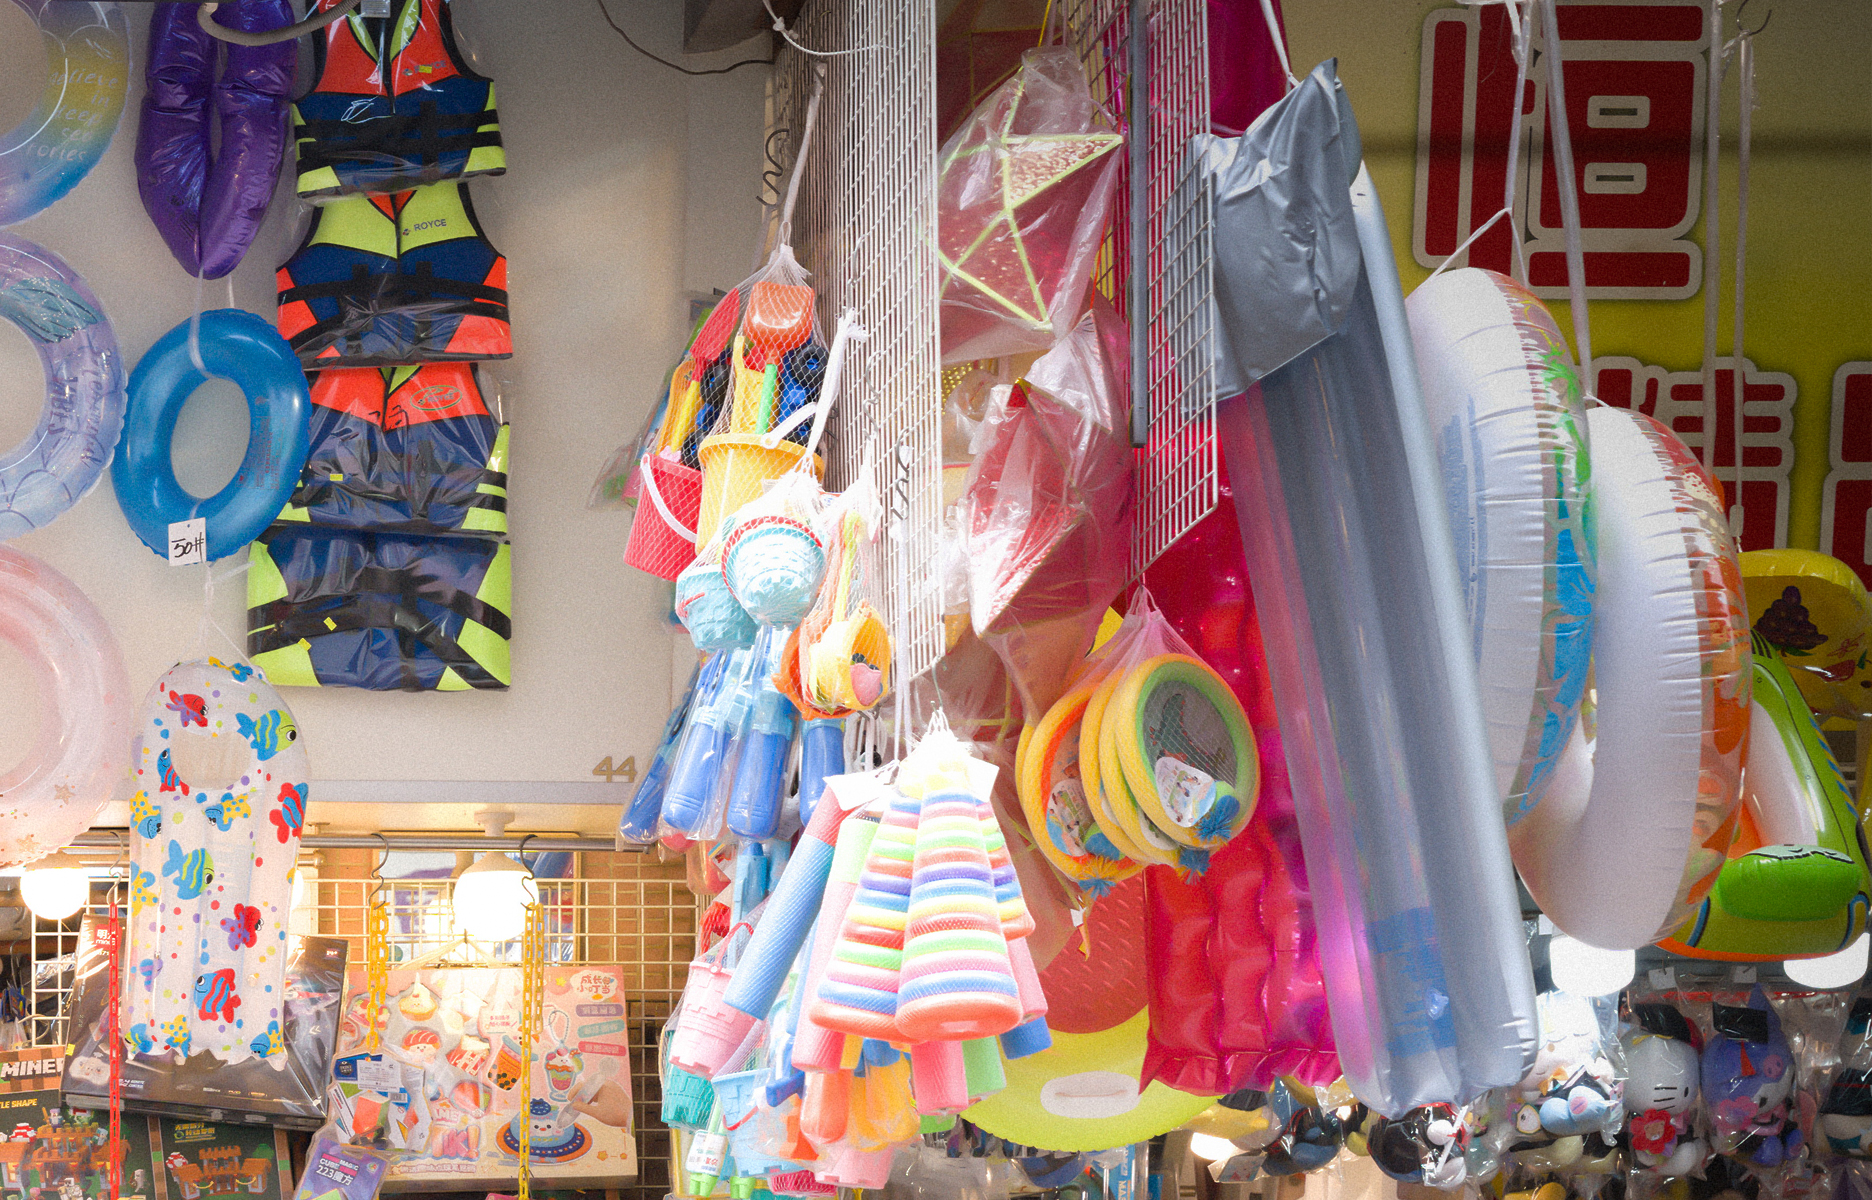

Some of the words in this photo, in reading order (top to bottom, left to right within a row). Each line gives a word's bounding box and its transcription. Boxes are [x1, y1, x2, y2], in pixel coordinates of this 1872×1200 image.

[1413, 0, 1703, 300] 恒
[413, 219, 447, 232] ROYCE
[593, 756, 637, 783] 44
[11, 1098, 38, 1108] SHAPE
